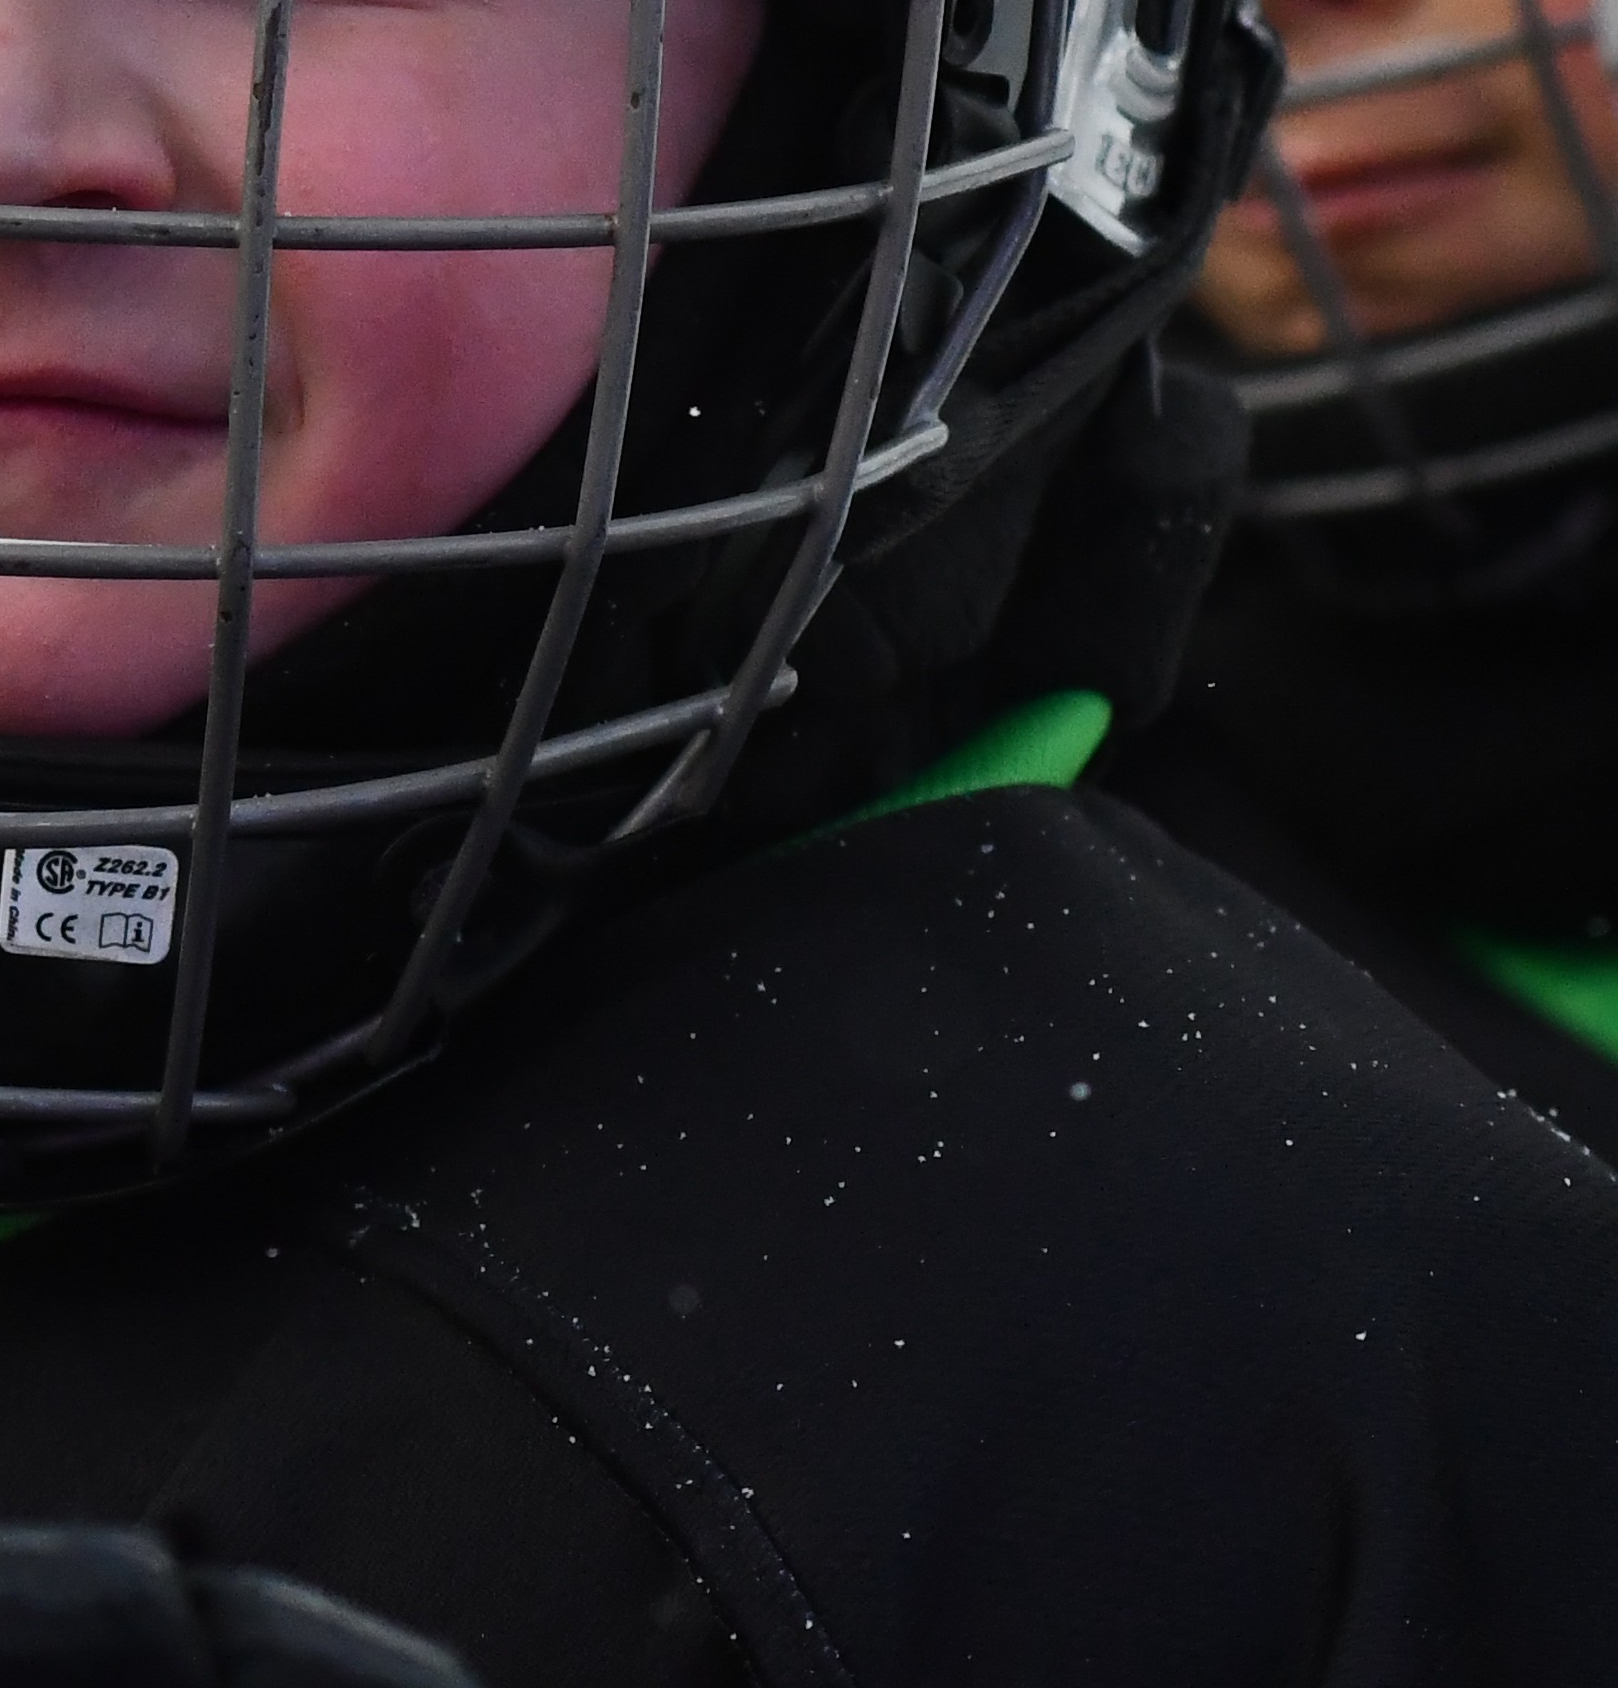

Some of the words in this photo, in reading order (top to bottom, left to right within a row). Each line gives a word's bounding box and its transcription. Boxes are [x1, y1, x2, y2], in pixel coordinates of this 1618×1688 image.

[93, 857, 167, 878] Z262.2
[85, 880, 140, 898] TYPE
[142, 884, 170, 901] B1
